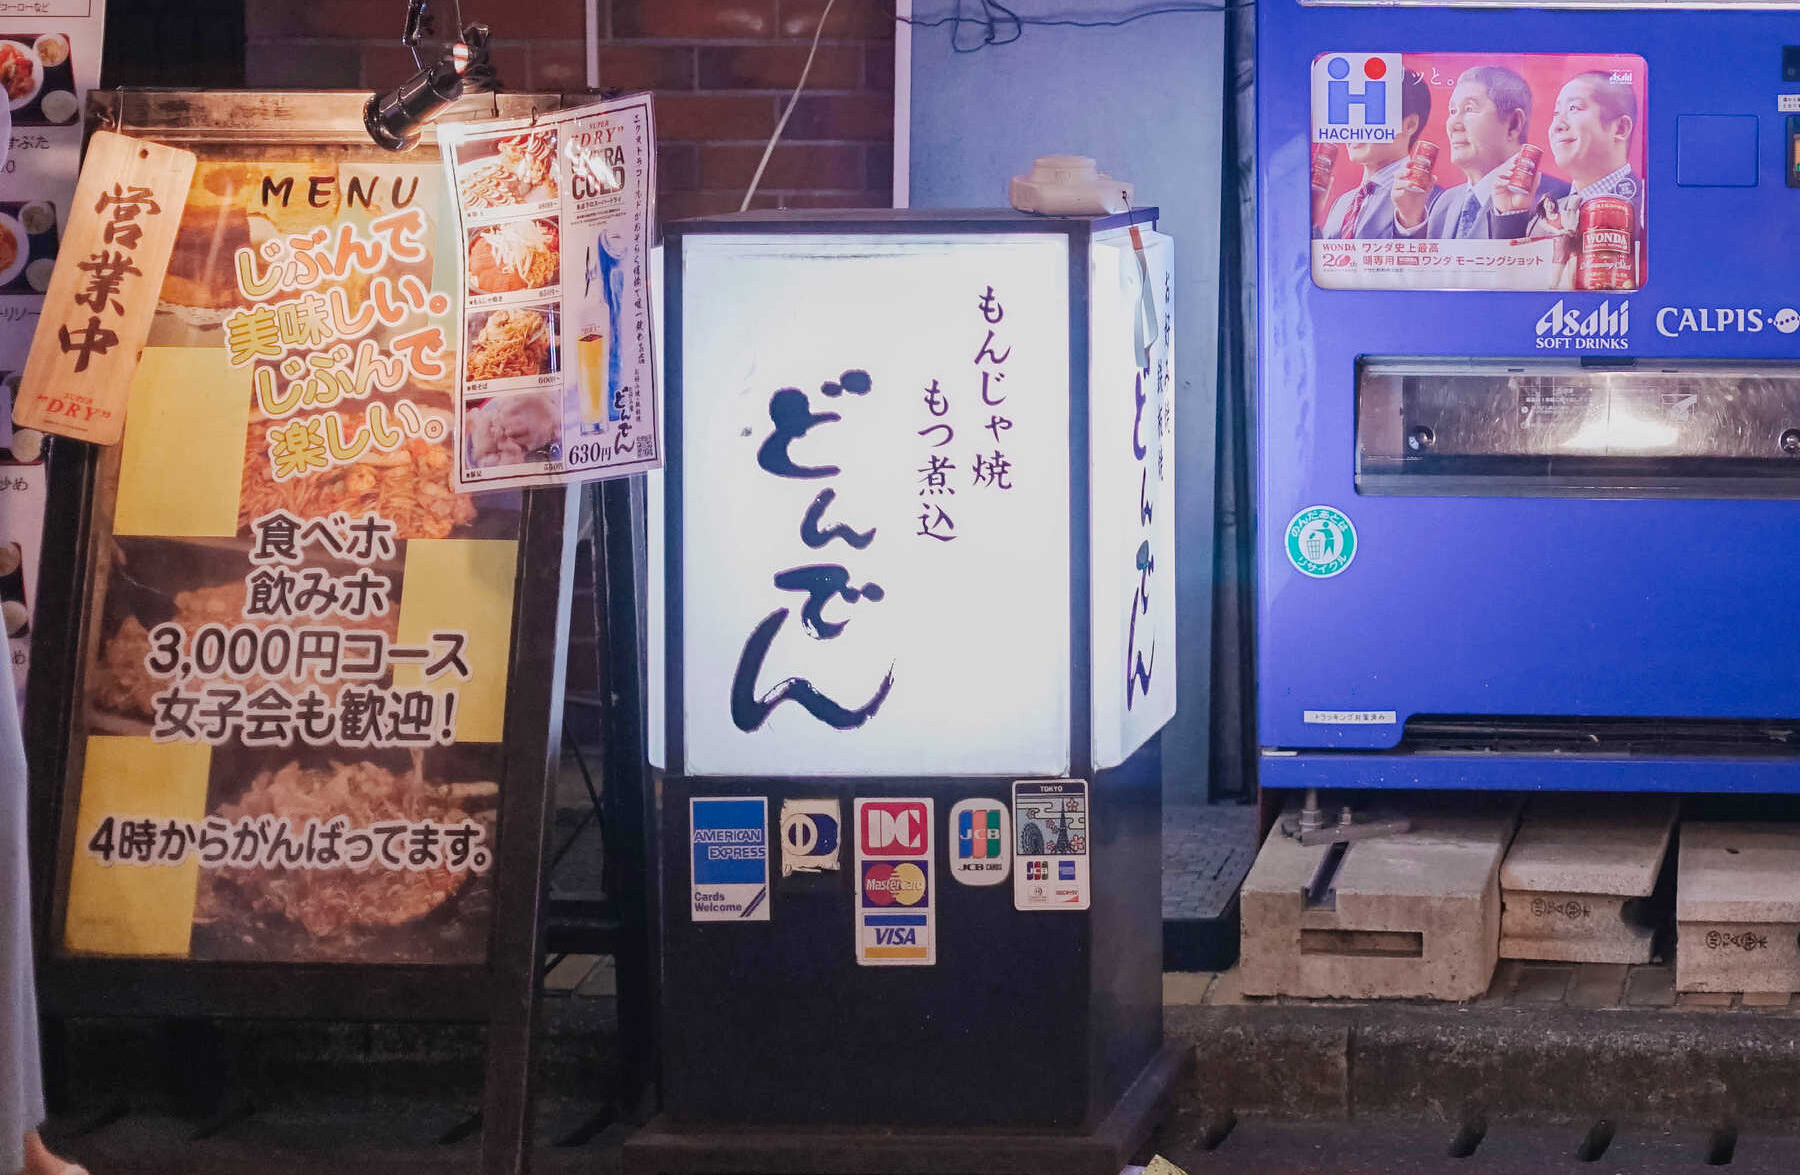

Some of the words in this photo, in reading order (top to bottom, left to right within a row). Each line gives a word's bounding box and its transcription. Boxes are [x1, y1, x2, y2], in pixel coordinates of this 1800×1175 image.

[1318, 127, 1395, 141] HACHIYOH
[261, 175, 420, 209] MENU
[1322, 242, 1357, 252] WONDA
[1362, 242, 1439, 254] ワンダ史上最高
[1585, 231, 1629, 247] WONDA
[238, 210, 428, 297] じぶんで
[1455, 255, 1544, 267] モーニングショット
[58, 181, 161, 374] 営業中
[1535, 299, 1630, 336] Asahi
[1655, 306, 1764, 336] CALPIS
[1535, 337, 1571, 350] SOFT
[1574, 337, 1629, 350] DRINKS
[259, 328, 446, 415] じぶんで
[972, 285, 1013, 490] もんじゃ焼
[569, 441, 612, 466] 630円
[917, 379, 957, 542] もつ煮込
[256, 514, 396, 561] 食べホ
[730, 369, 896, 733] どんでん
[250, 572, 389, 616] 飲みホ
[150, 628, 469, 678] 3,000円コース
[156, 689, 455, 740] 女子会も歓迎!
[1040, 785, 1063, 793] TOKYO
[694, 829, 762, 844] AMERICAN
[867, 809, 922, 849] DC
[960, 828, 1001, 842] JCB
[90, 816, 492, 868] 4時からがんばってます。
[708, 845, 767, 860] EXPRESS
[958, 863, 984, 871] JCB
[694, 892, 726, 902] Cards
[865, 876, 929, 894] MasterCard
[694, 902, 743, 913] Welcome
[874, 927, 917, 946] VISA
